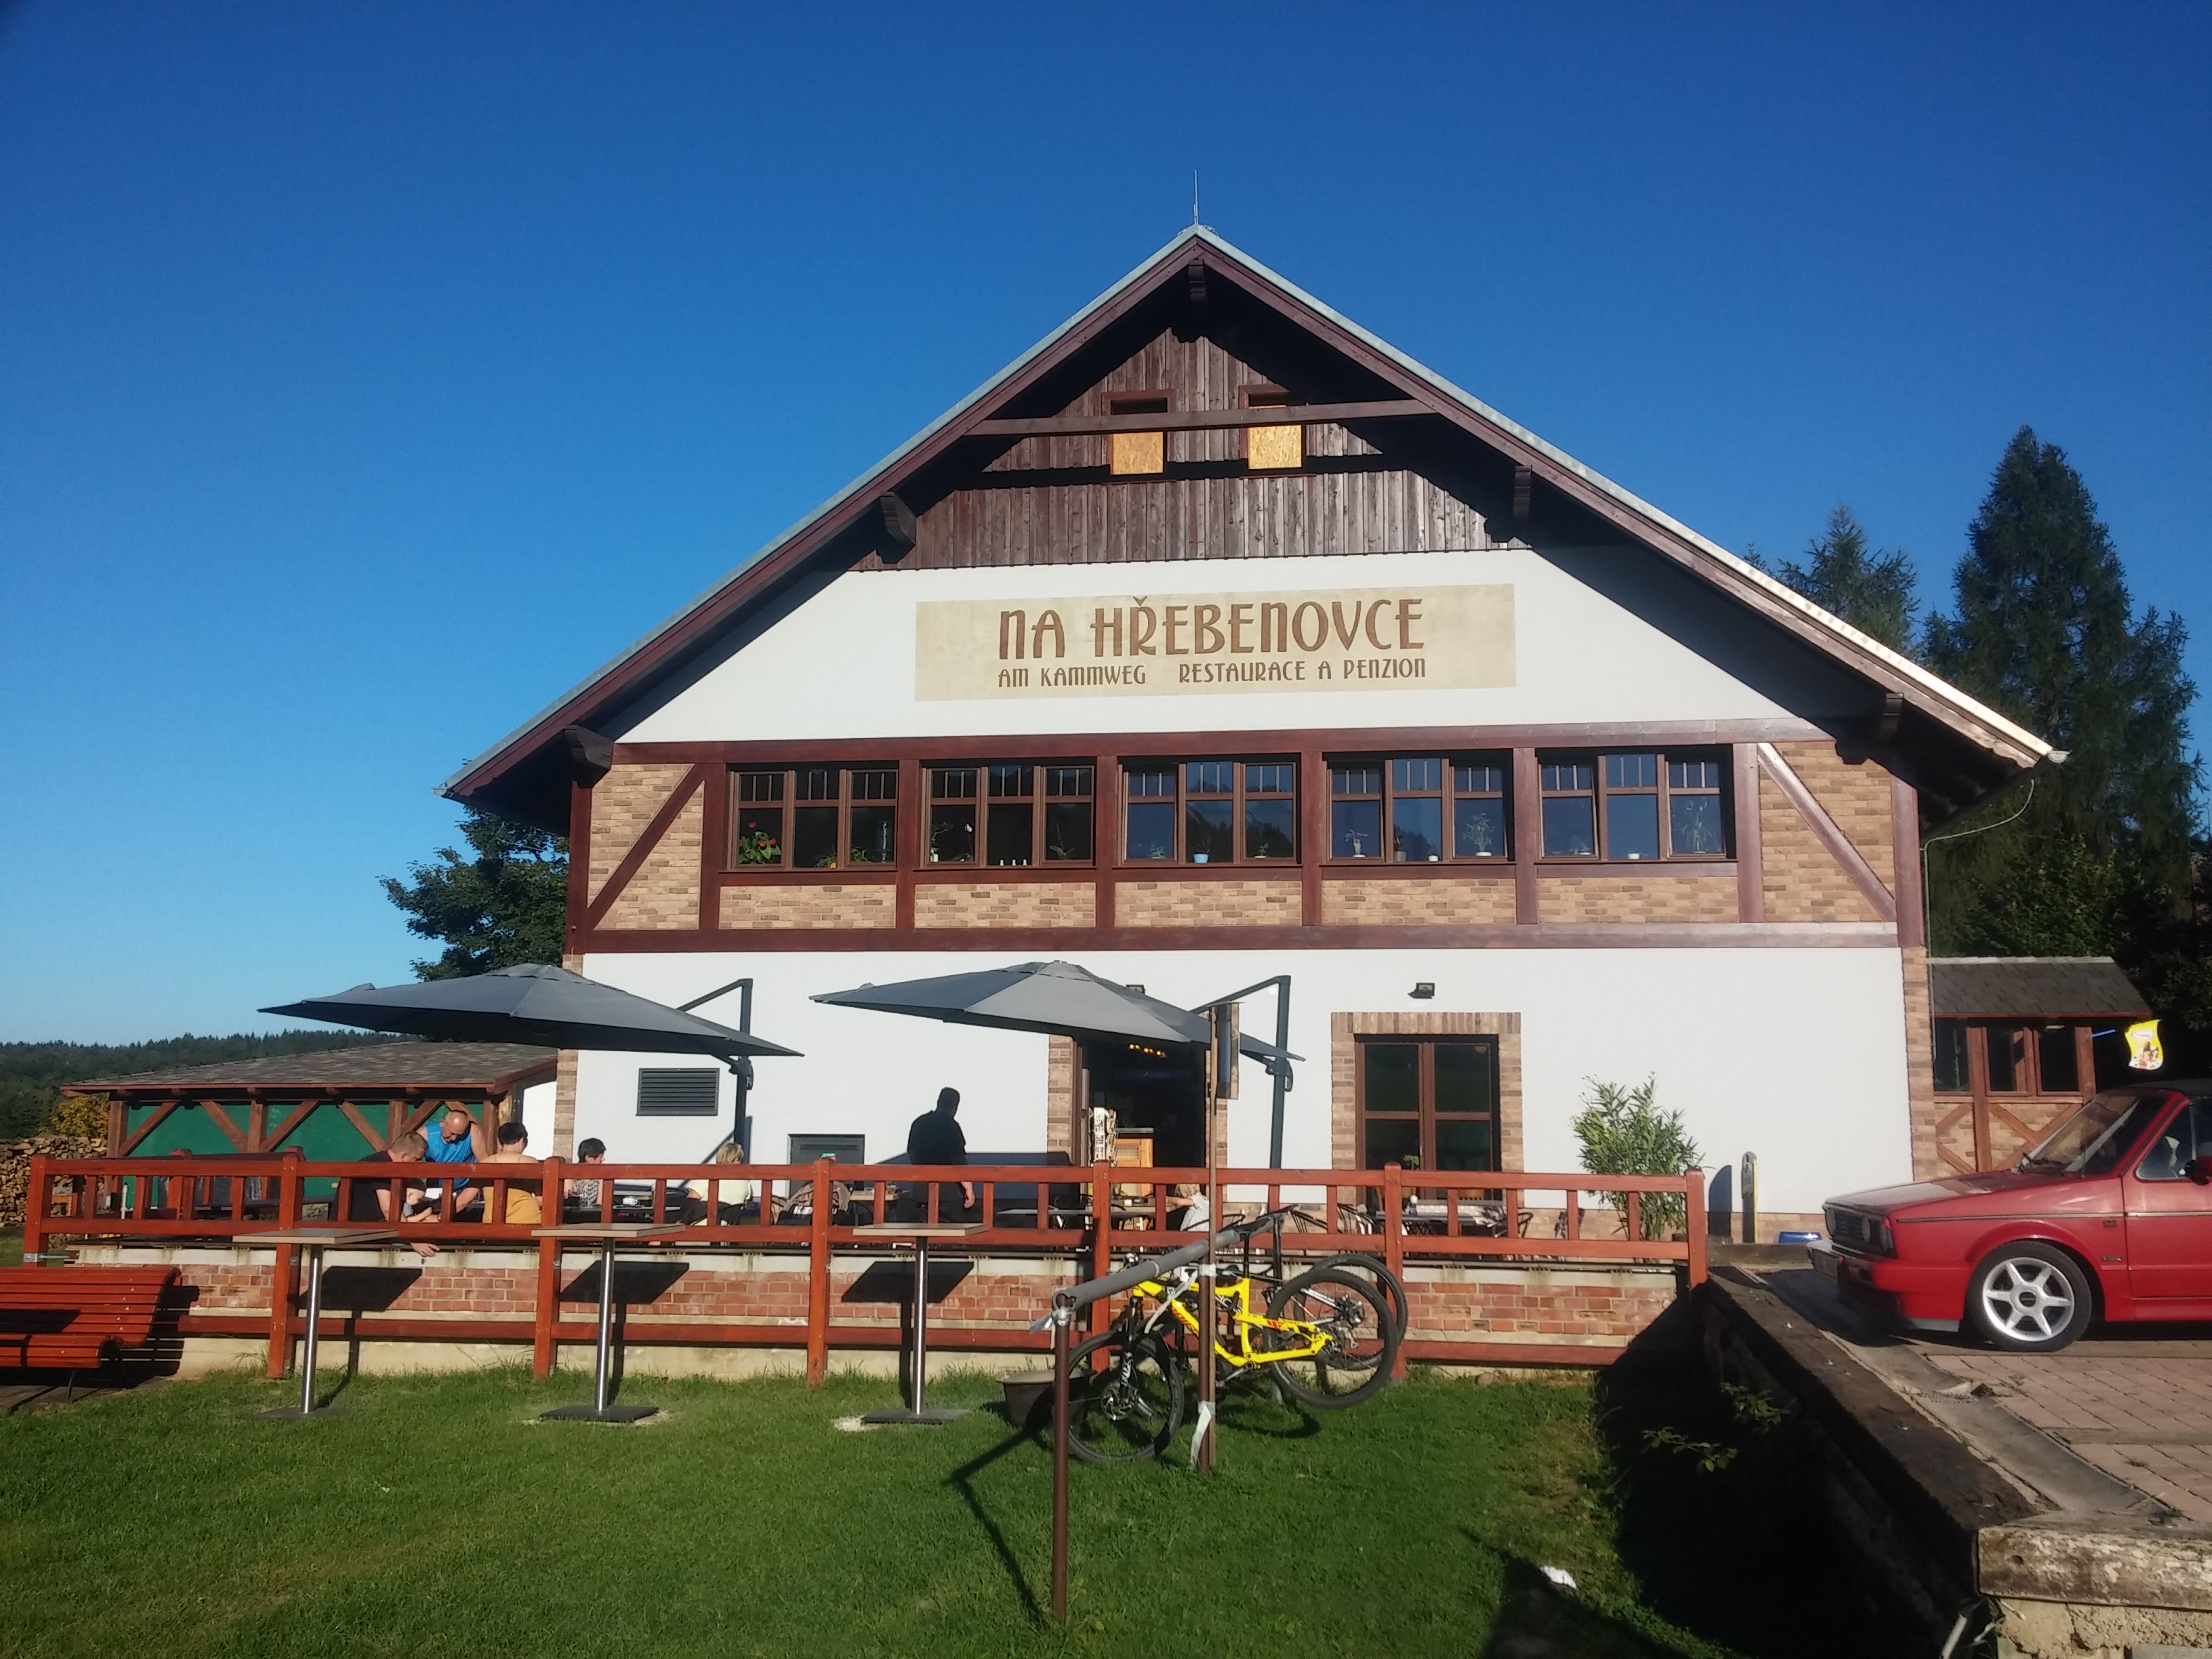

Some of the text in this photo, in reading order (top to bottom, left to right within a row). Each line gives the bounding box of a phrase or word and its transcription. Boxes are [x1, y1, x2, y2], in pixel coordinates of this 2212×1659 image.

[999, 596, 1425, 659] NA HŘEBENOVCE
[998, 665, 1146, 688] AM KAMMWEG
[1179, 658, 1426, 683] RESTAURACE A PENZION
